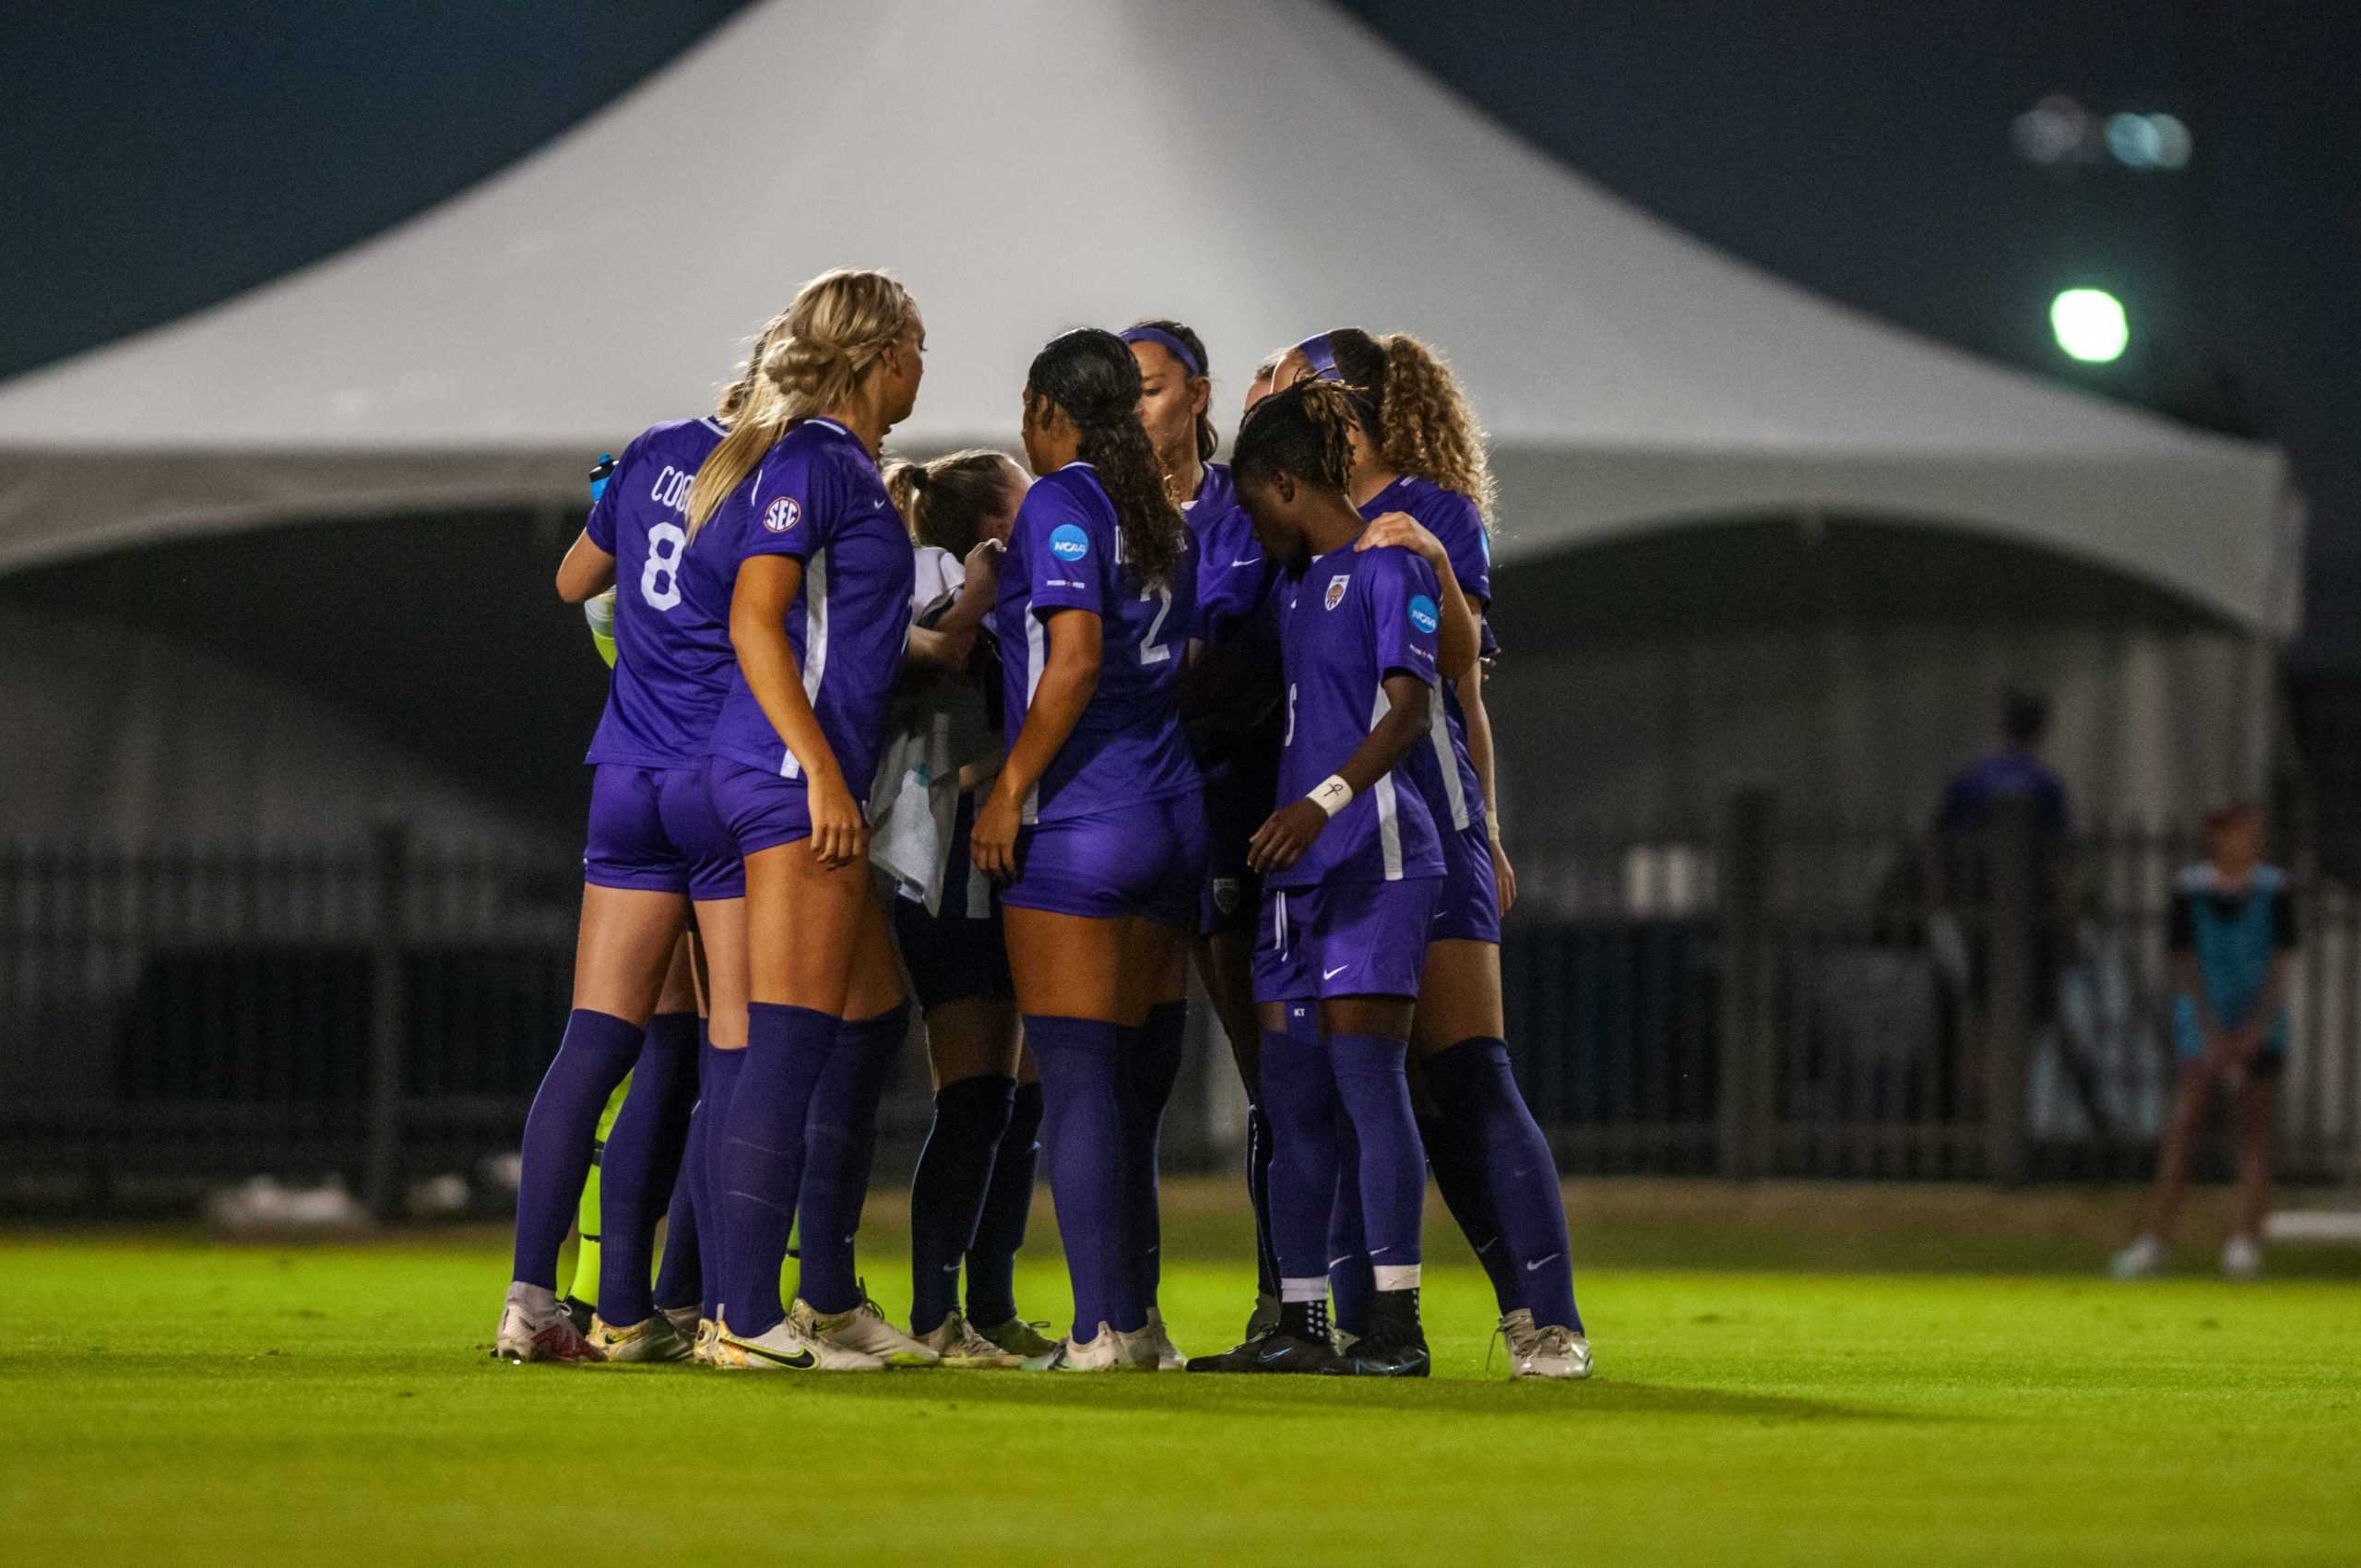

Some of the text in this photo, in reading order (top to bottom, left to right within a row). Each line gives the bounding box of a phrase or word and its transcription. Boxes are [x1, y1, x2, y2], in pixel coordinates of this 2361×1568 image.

[766, 500, 798, 530] SEC
[1054, 541, 1086, 552] NCAA
[641, 521, 686, 612] 8
[1140, 577, 1172, 665] 2
[1412, 610, 1436, 628] NCAA
